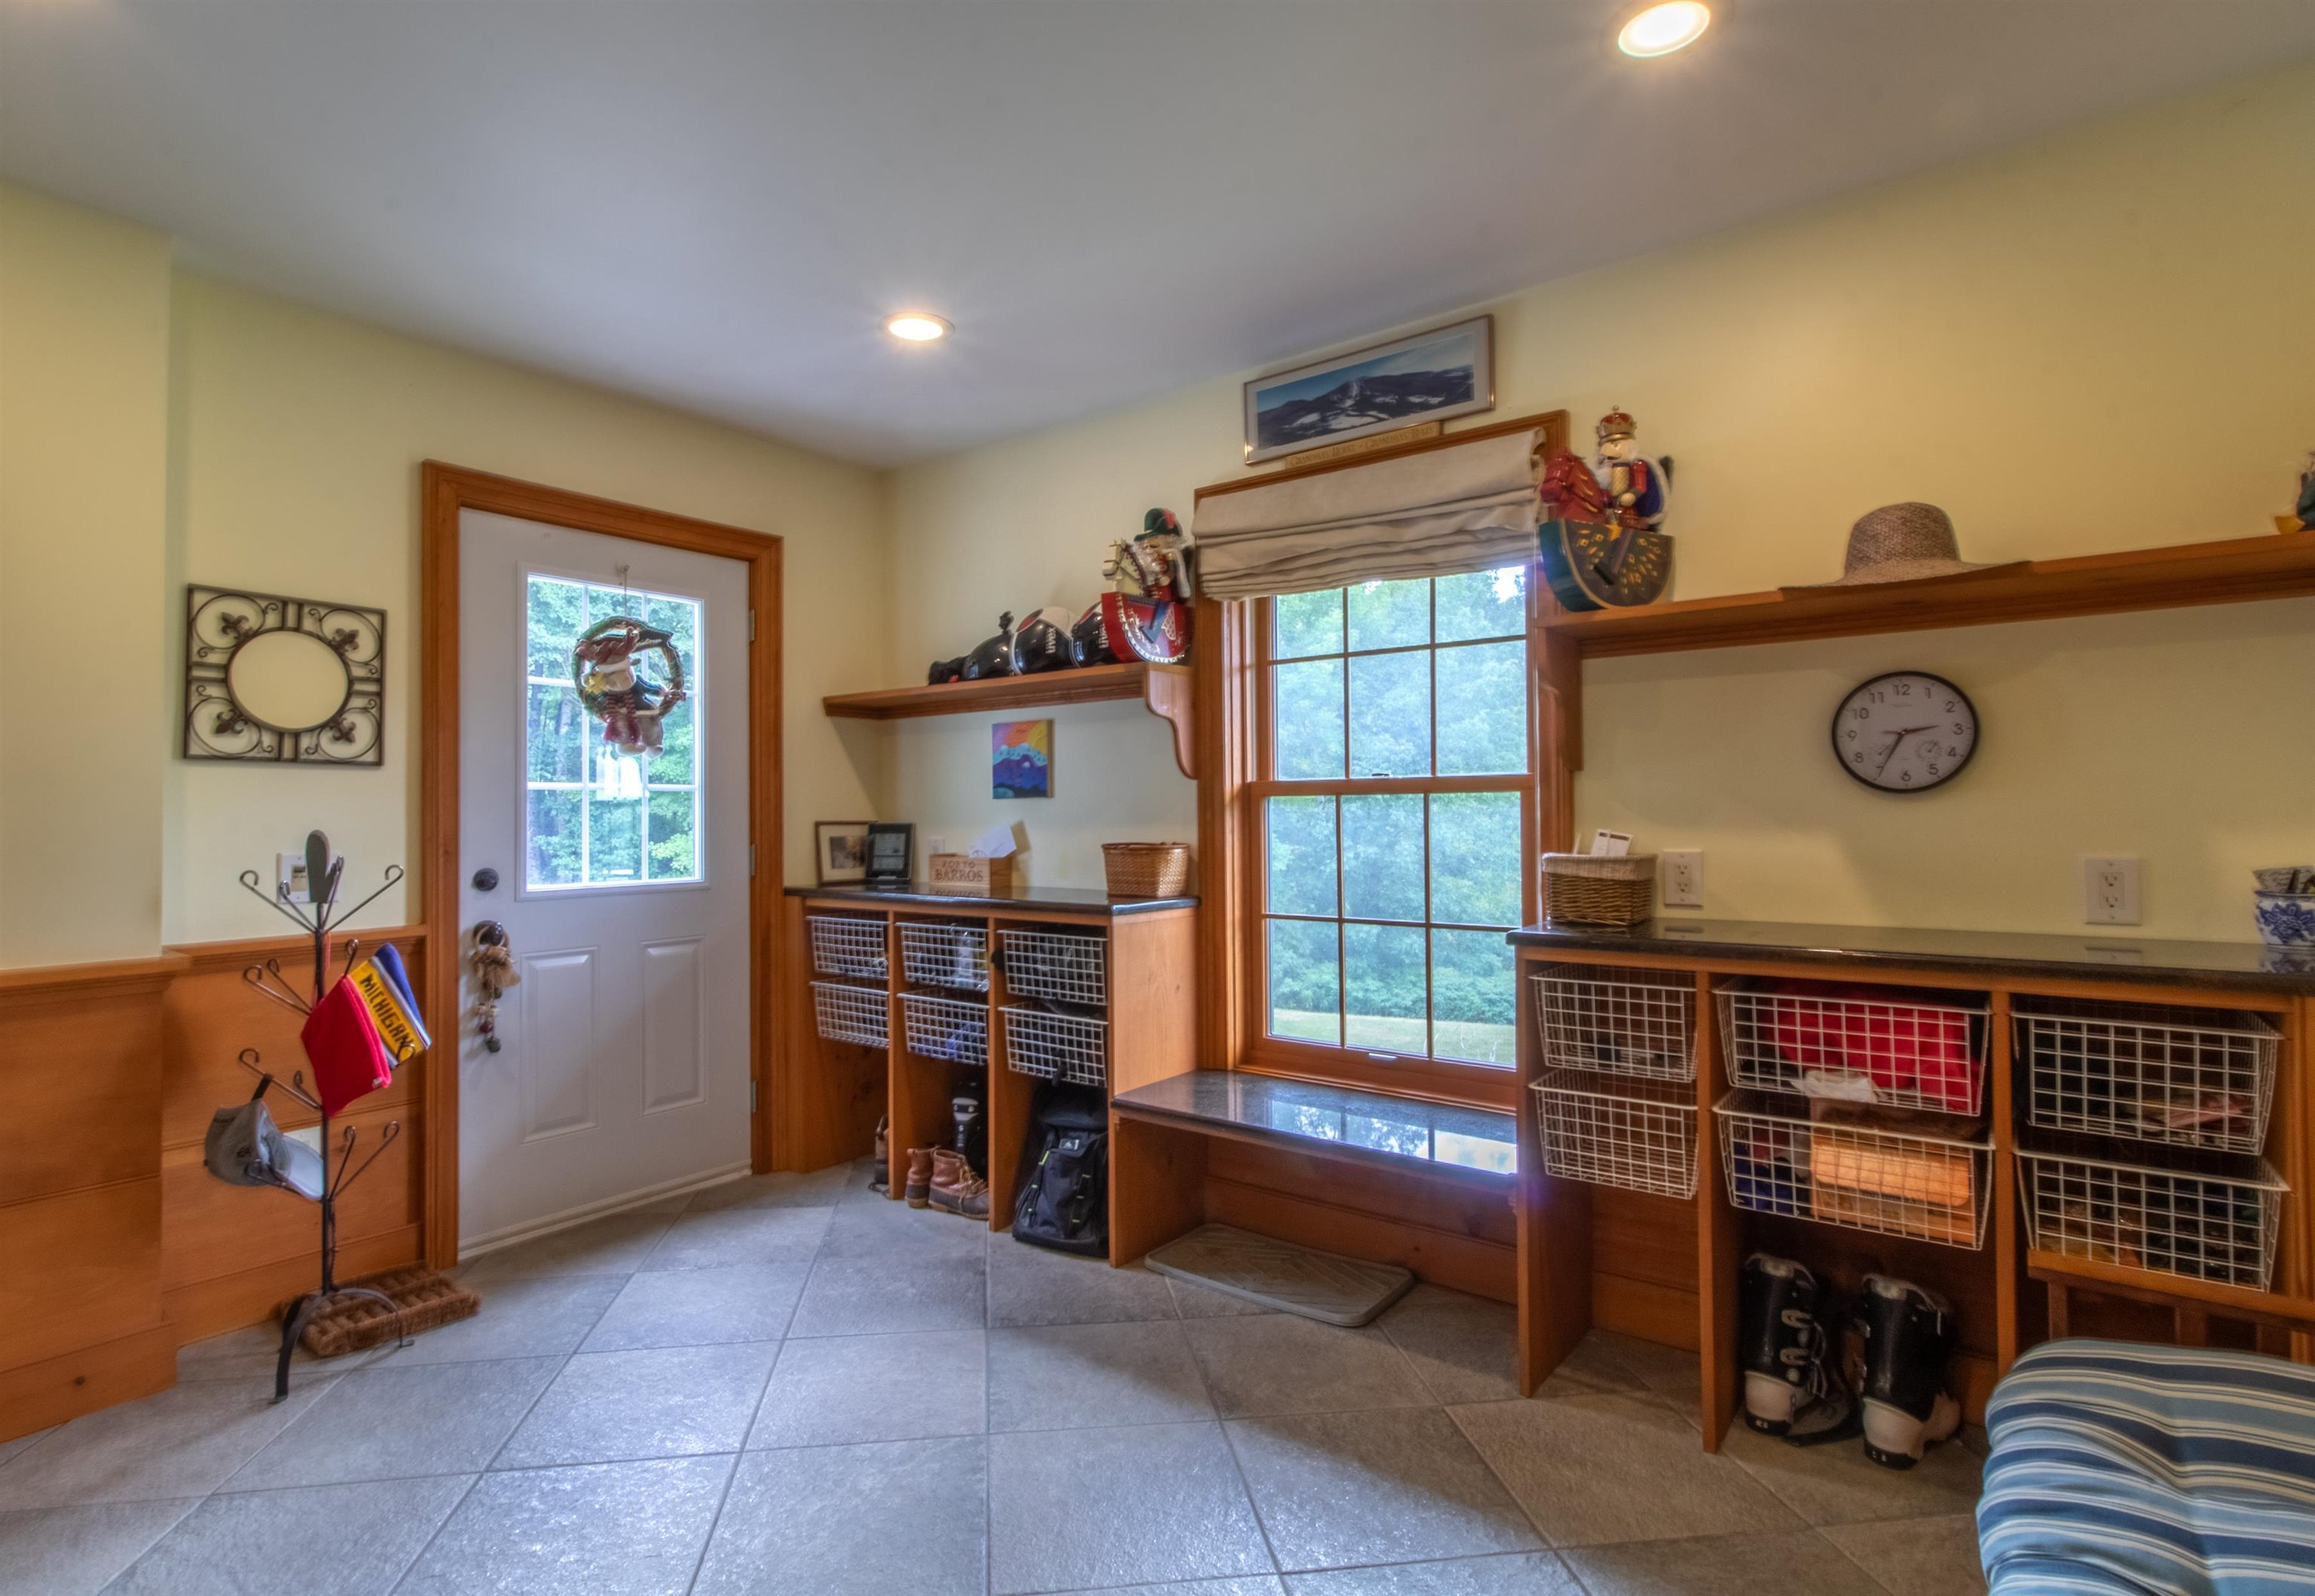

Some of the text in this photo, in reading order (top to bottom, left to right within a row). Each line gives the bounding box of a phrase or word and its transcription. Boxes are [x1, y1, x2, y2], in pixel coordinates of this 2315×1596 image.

[1045, 627, 1056, 654] uvex
[1099, 622, 1109, 648] uve
[1894, 683, 1910, 696] 12
[1925, 687, 1931, 699] 1
[1870, 692, 1885, 703] 11
[1946, 701, 1956, 713] 2
[1852, 708, 1869, 720] 10
[1953, 723, 1963, 735] 3
[1848, 730, 1857, 741] 9
[1855, 752, 1864, 763] 8
[1947, 747, 1957, 758] 4
[1876, 766, 1884, 778] 7
[1929, 763, 1938, 775] 5
[1902, 770, 1911, 781] 6
[935, 868, 983, 882] BARROS
[359, 973, 414, 1047] MICHIGAN
